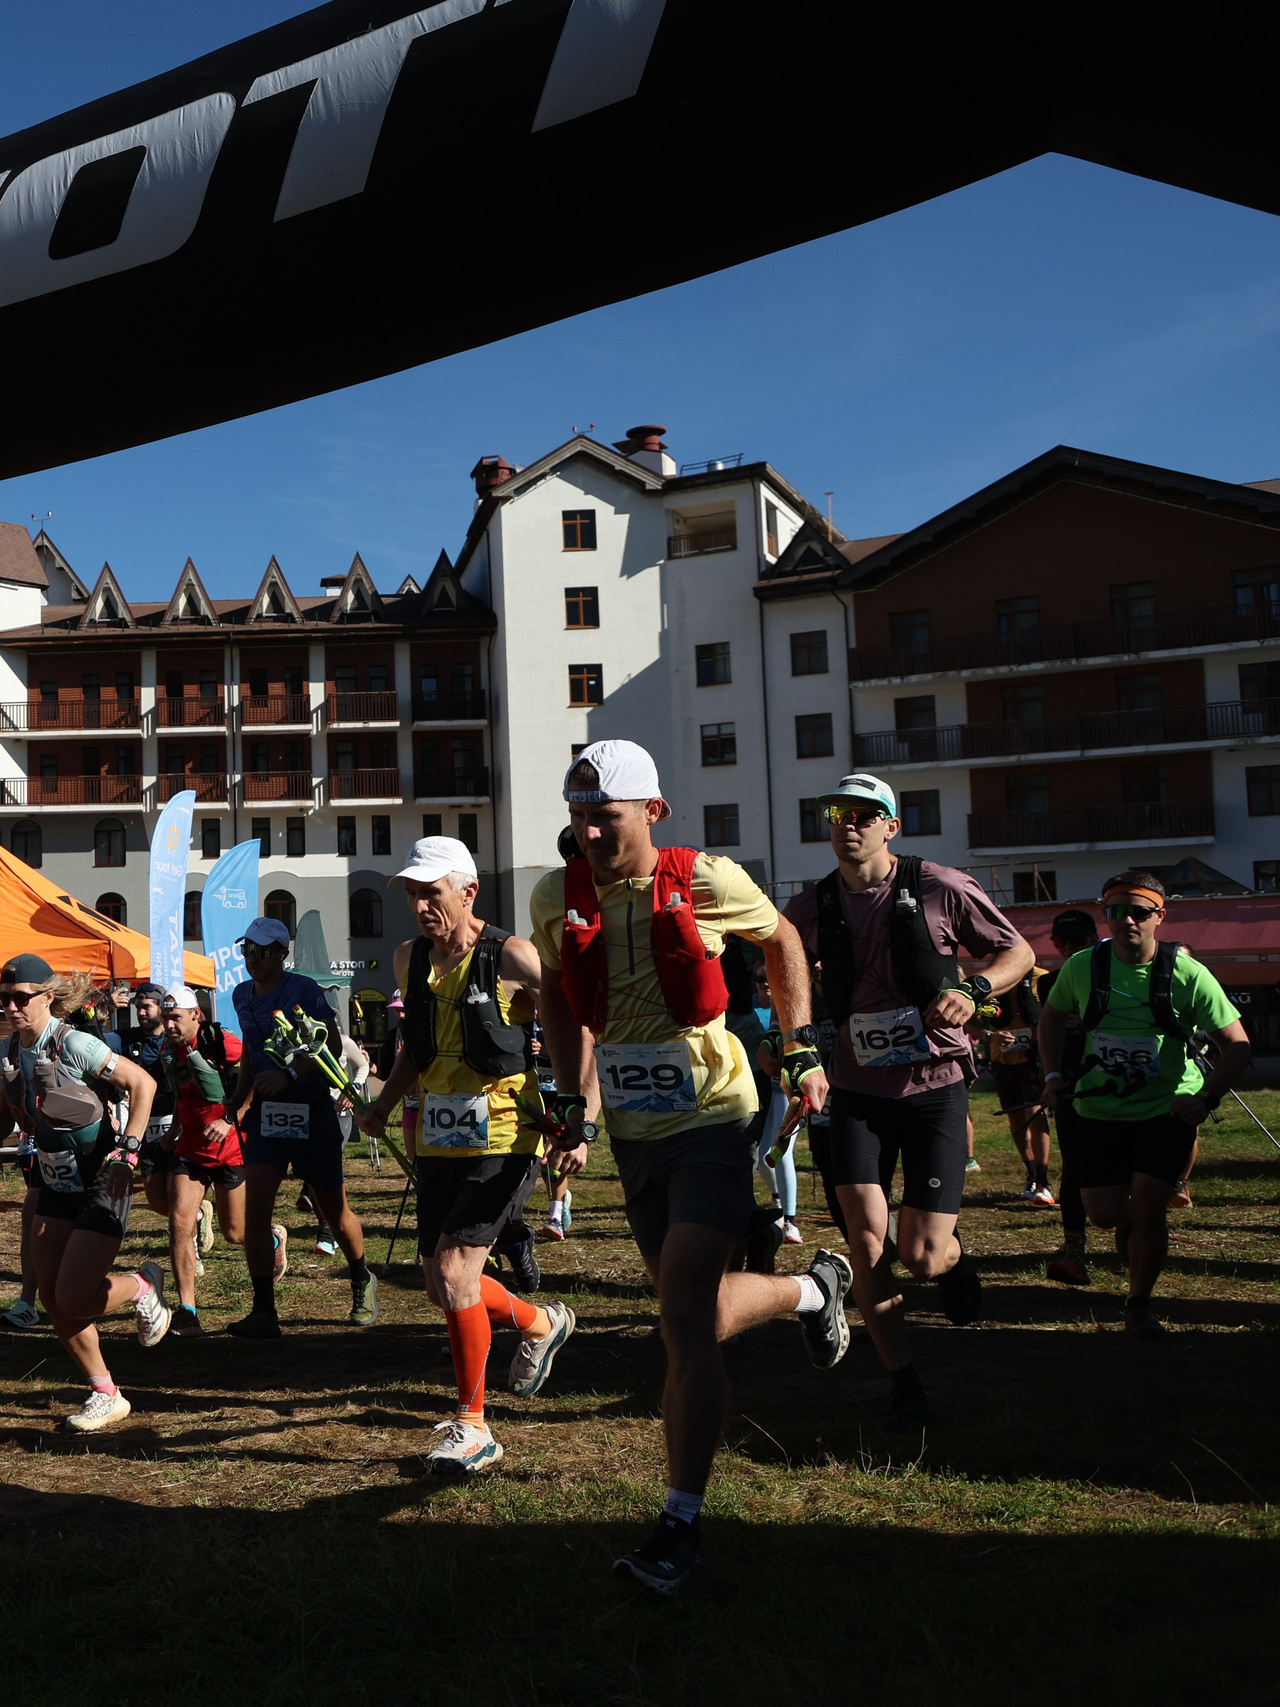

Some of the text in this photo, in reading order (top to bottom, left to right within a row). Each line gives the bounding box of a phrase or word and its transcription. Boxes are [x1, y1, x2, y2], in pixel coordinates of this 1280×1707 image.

[856, 1025, 917, 1050] 162
[606, 1064, 683, 1090] 129
[266, 1112, 305, 1127] 132
[428, 1108, 479, 1130] 104
[88, 1400, 115, 1420] TERREX
